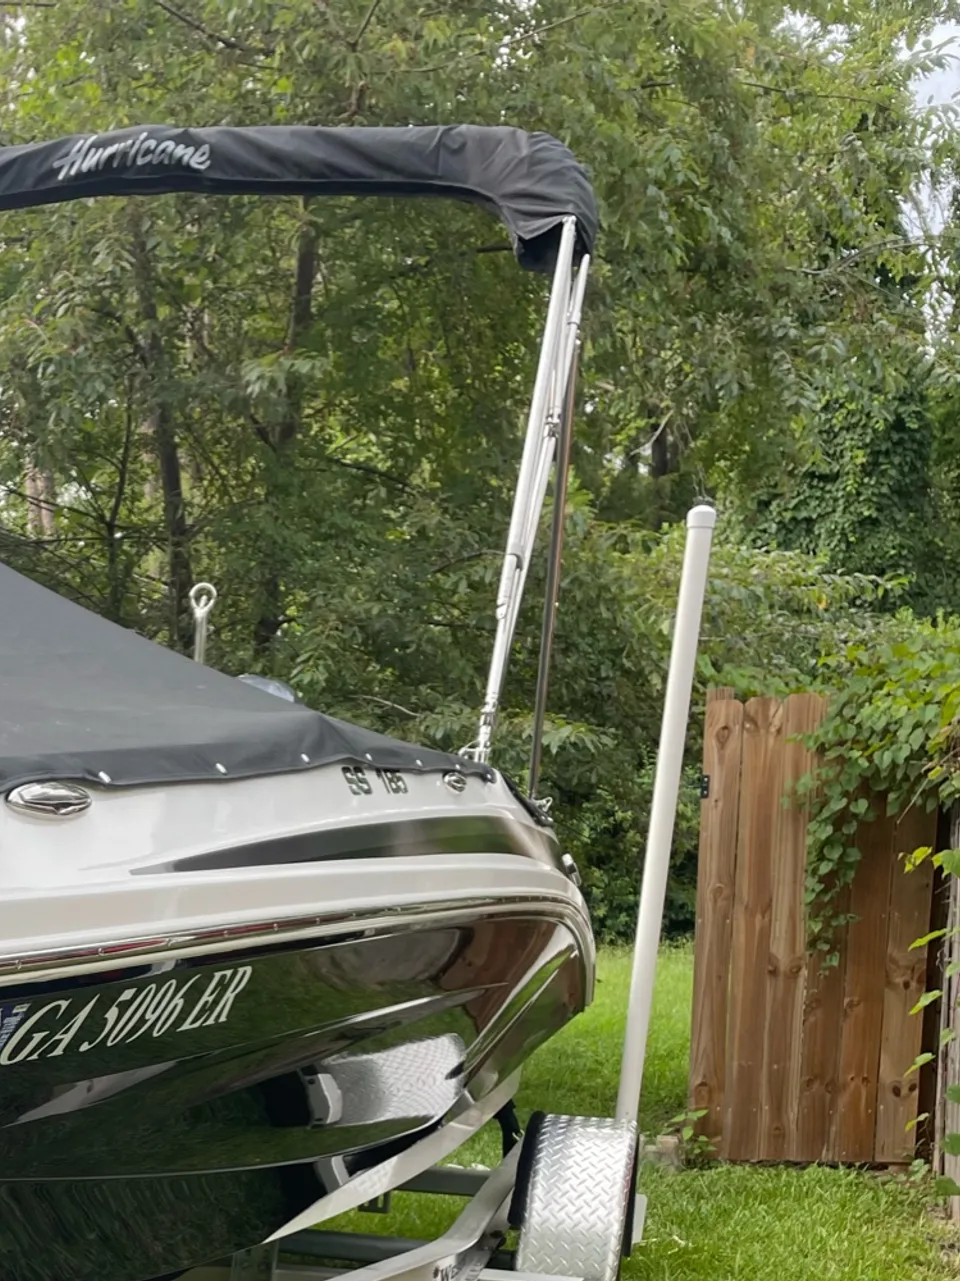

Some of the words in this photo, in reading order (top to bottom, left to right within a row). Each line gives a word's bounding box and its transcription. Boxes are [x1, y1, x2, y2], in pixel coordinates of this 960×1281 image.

[52, 132, 212, 180] Hurricane
[341, 766, 373, 795] SS
[0, 993, 100, 1065] GA
[79, 974, 201, 1052] 5096
[176, 965, 253, 1033] ER
